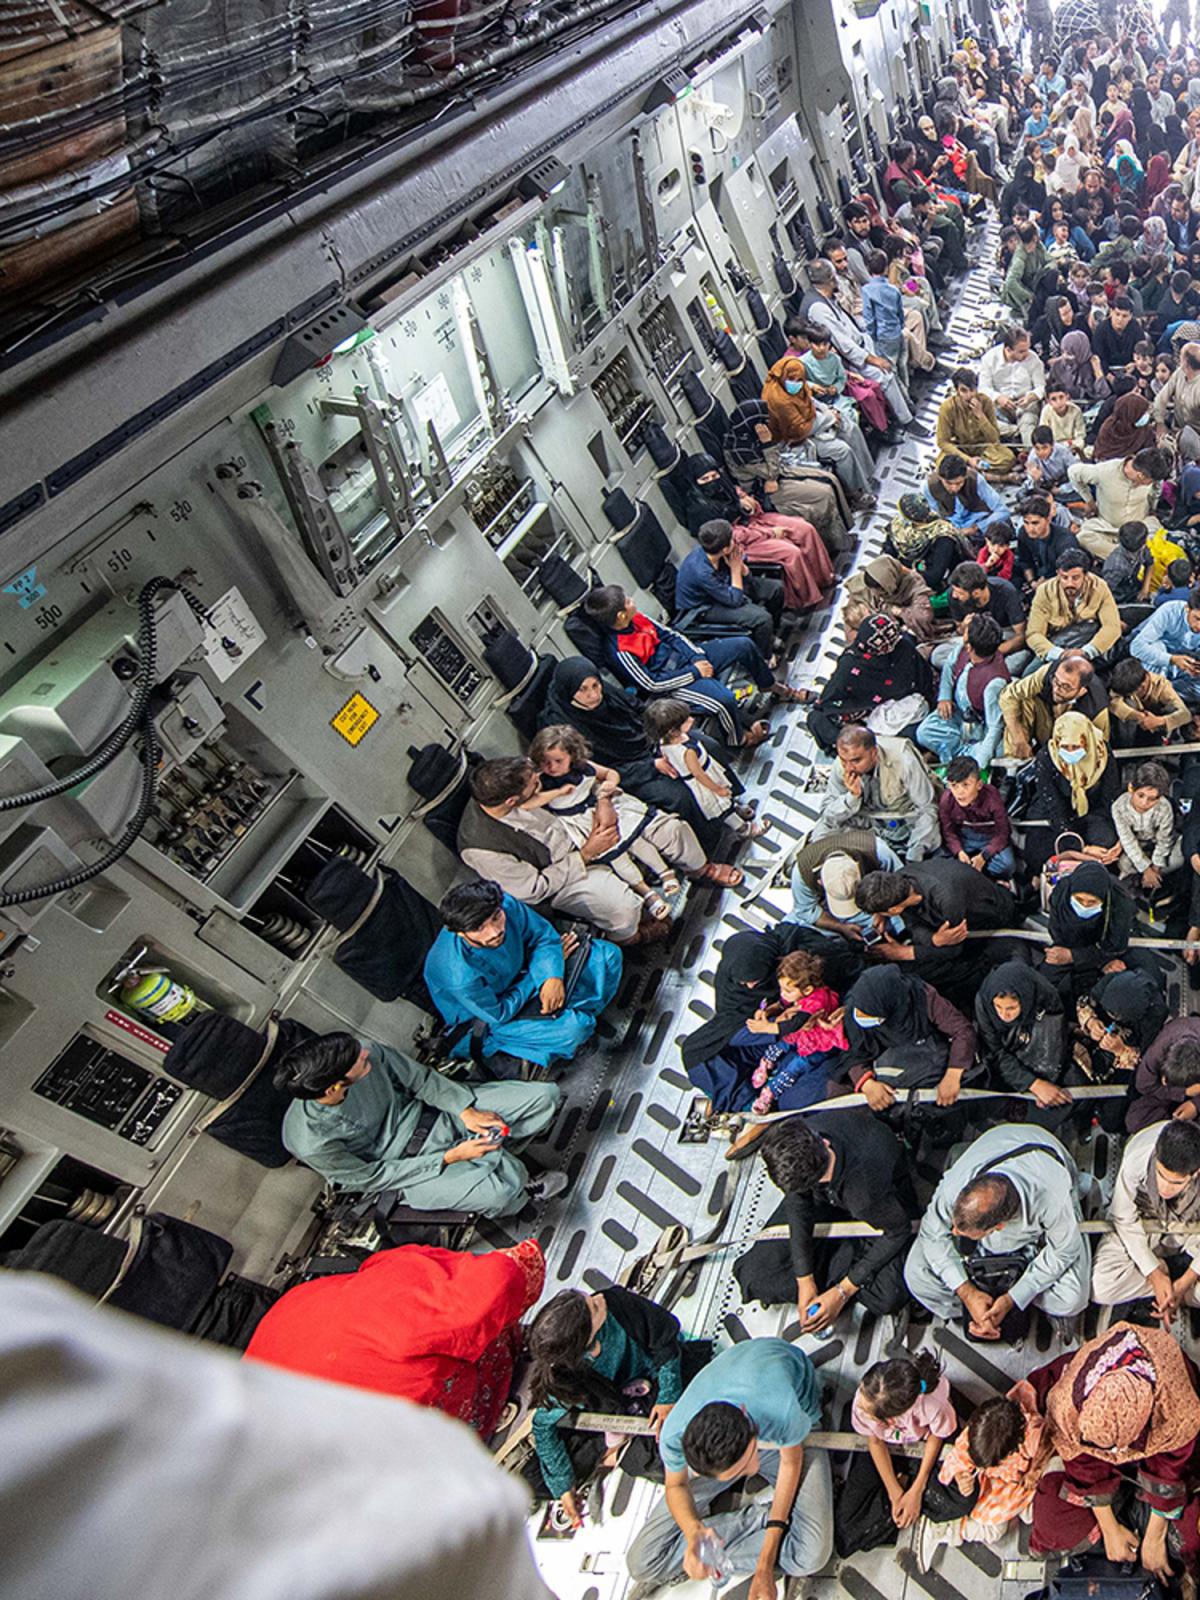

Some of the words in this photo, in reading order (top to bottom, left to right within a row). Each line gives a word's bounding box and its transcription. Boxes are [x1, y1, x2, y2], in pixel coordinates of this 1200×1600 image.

[316, 364, 333, 383] 550
[170, 500, 192, 522] 520
[107, 548, 132, 573] 510
[35, 604, 63, 630] 500
